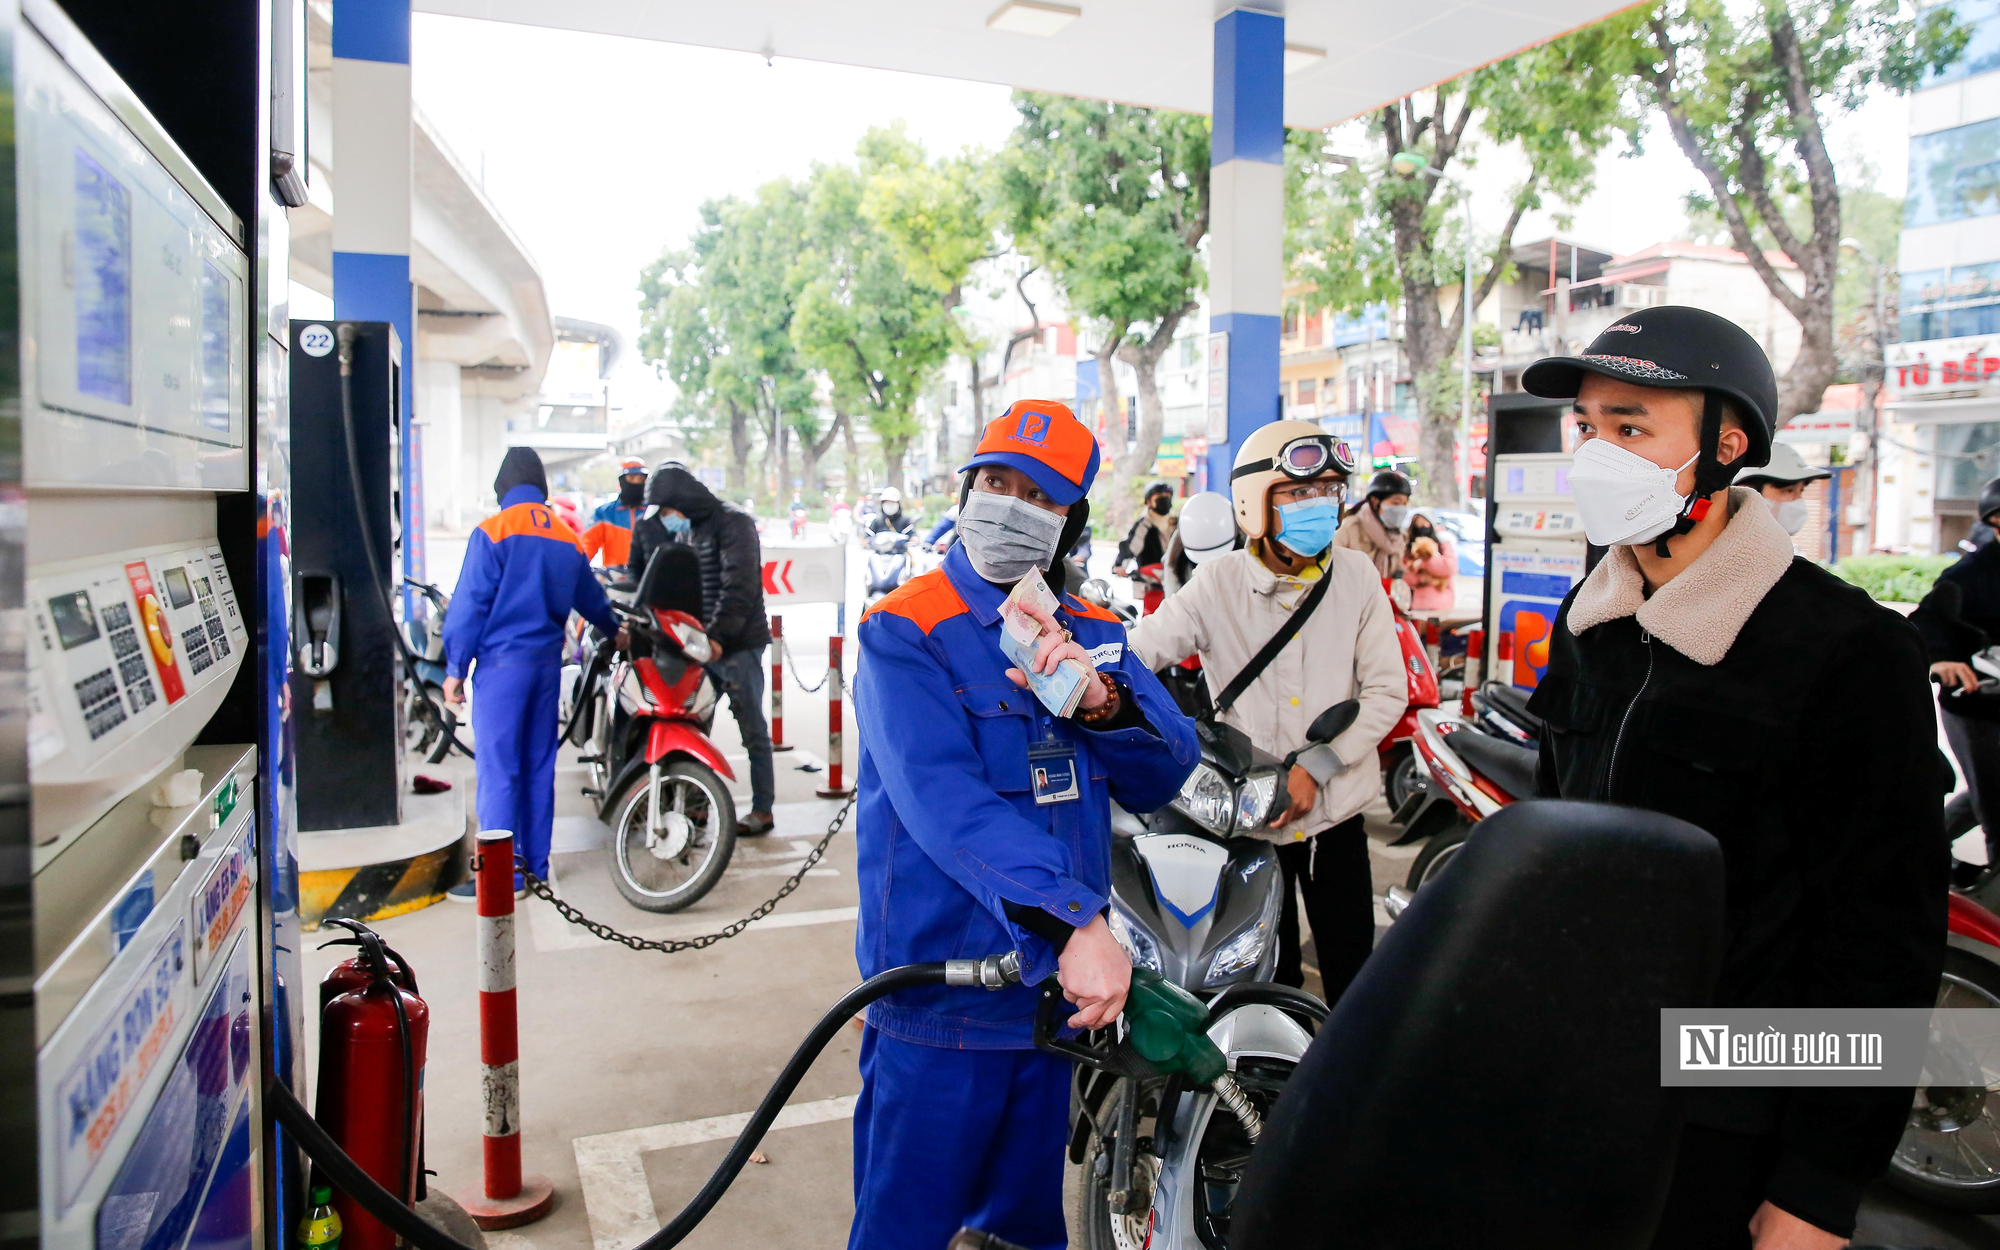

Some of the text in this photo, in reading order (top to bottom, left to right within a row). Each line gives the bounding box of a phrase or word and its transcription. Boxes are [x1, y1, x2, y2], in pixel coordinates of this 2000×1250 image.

[306, 334, 329, 348] 22
[1897, 348, 2000, 387] TỦ BẾP
[1167, 843, 1207, 854] HONDA
